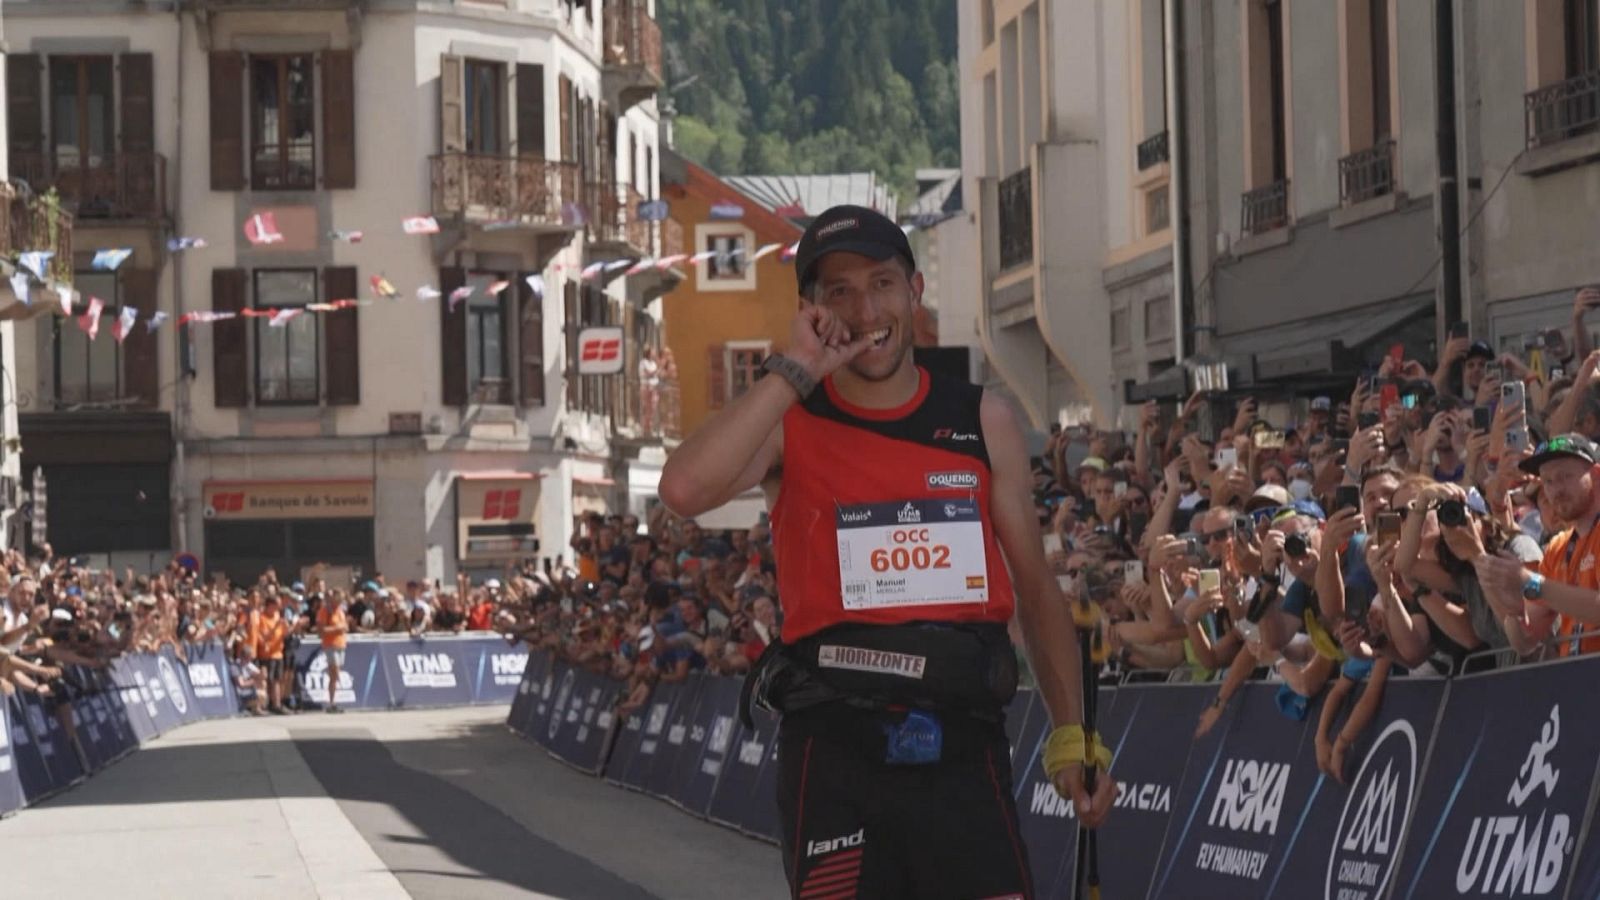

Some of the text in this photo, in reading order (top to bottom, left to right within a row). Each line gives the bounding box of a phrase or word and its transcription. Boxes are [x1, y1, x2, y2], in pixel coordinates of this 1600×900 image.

[929, 474, 978, 487] OQUENDO
[251, 494, 369, 511] Banque de Savoie
[893, 529, 929, 544] OCC
[870, 545, 951, 572] 6002
[876, 578, 905, 586] Manuel
[397, 653, 453, 673] UTMB
[491, 653, 529, 674] HOK
[835, 647, 923, 673] HORIZONTE
[1208, 759, 1291, 836] HOKA
[1196, 843, 1269, 880] FLY HUMAN FLY
[1456, 808, 1570, 898] UTMB
